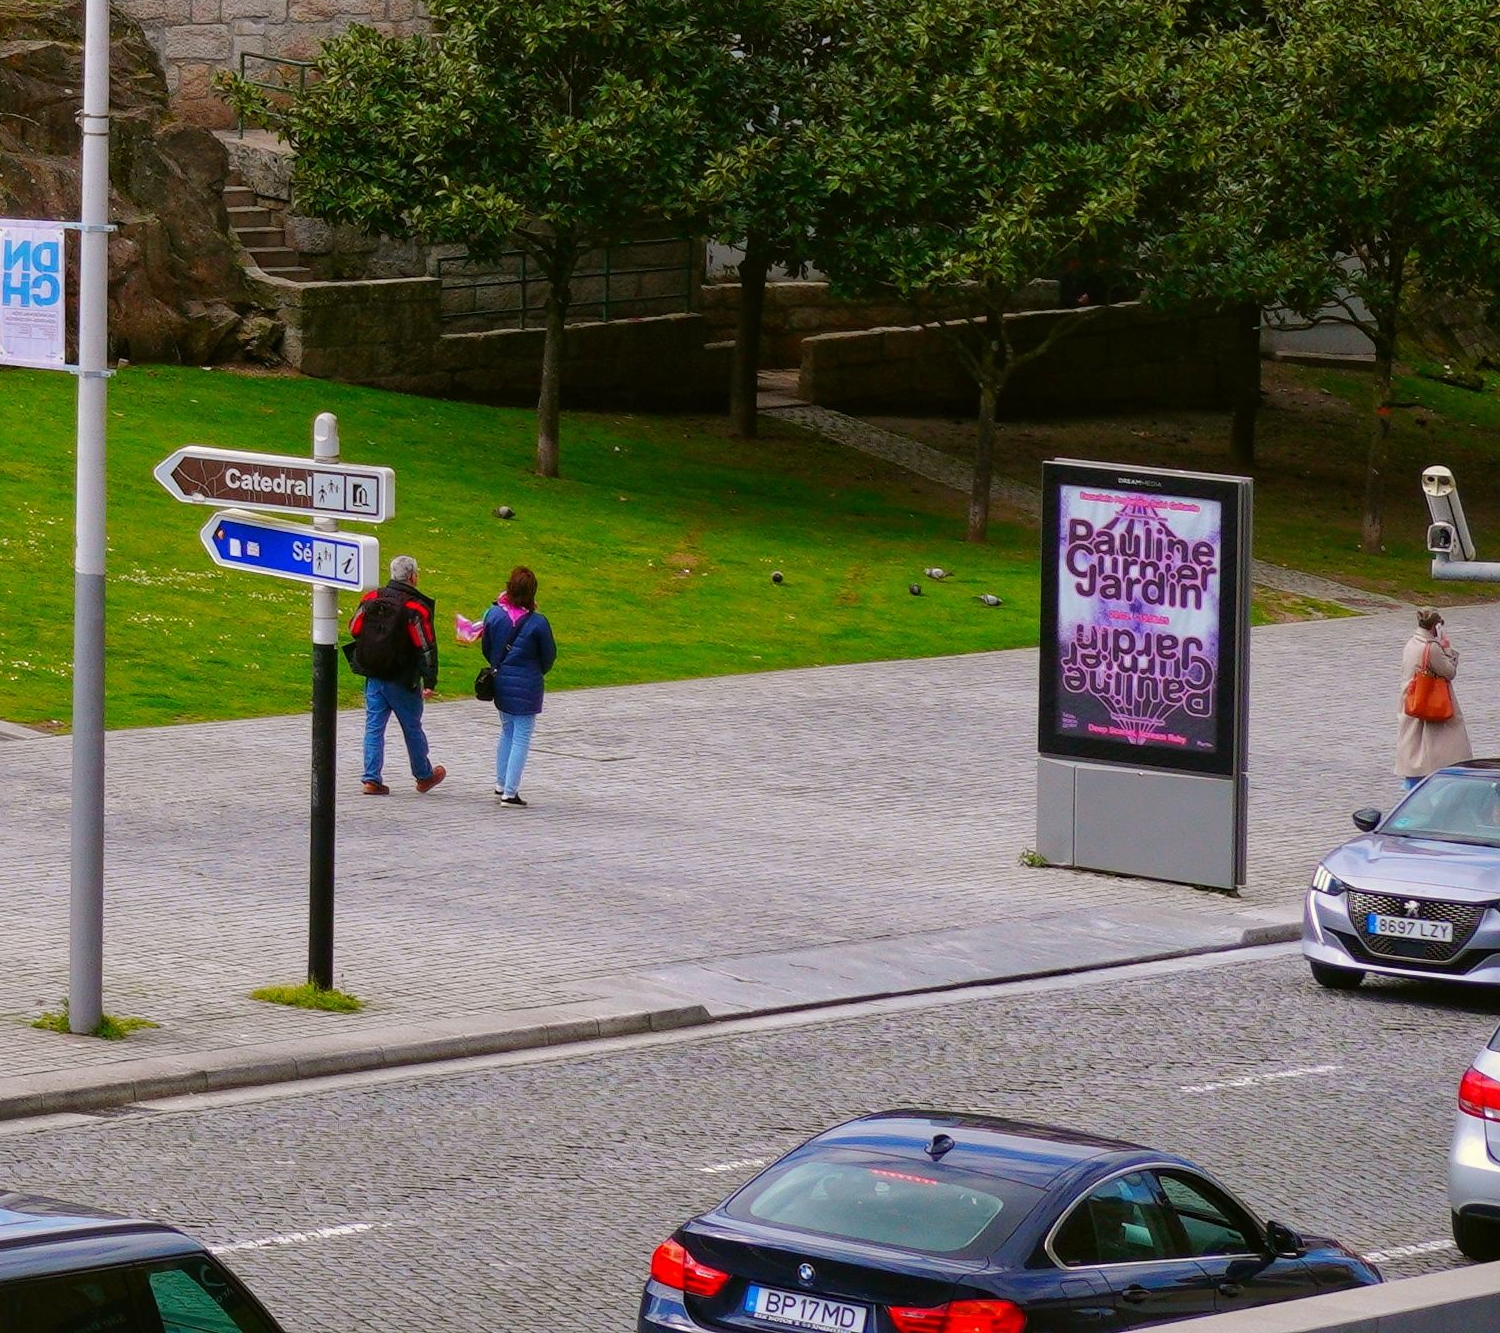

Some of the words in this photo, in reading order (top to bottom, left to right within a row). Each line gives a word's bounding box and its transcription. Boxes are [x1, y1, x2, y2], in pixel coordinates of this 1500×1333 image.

[225, 468, 313, 497] Catedral
[292, 540, 313, 563] Sé
[1068, 518, 1215, 567] Pauline
[1074, 563, 1202, 610] Jardin
[1379, 918, 1416, 935] 8697
[1419, 923, 1450, 939] LZY
